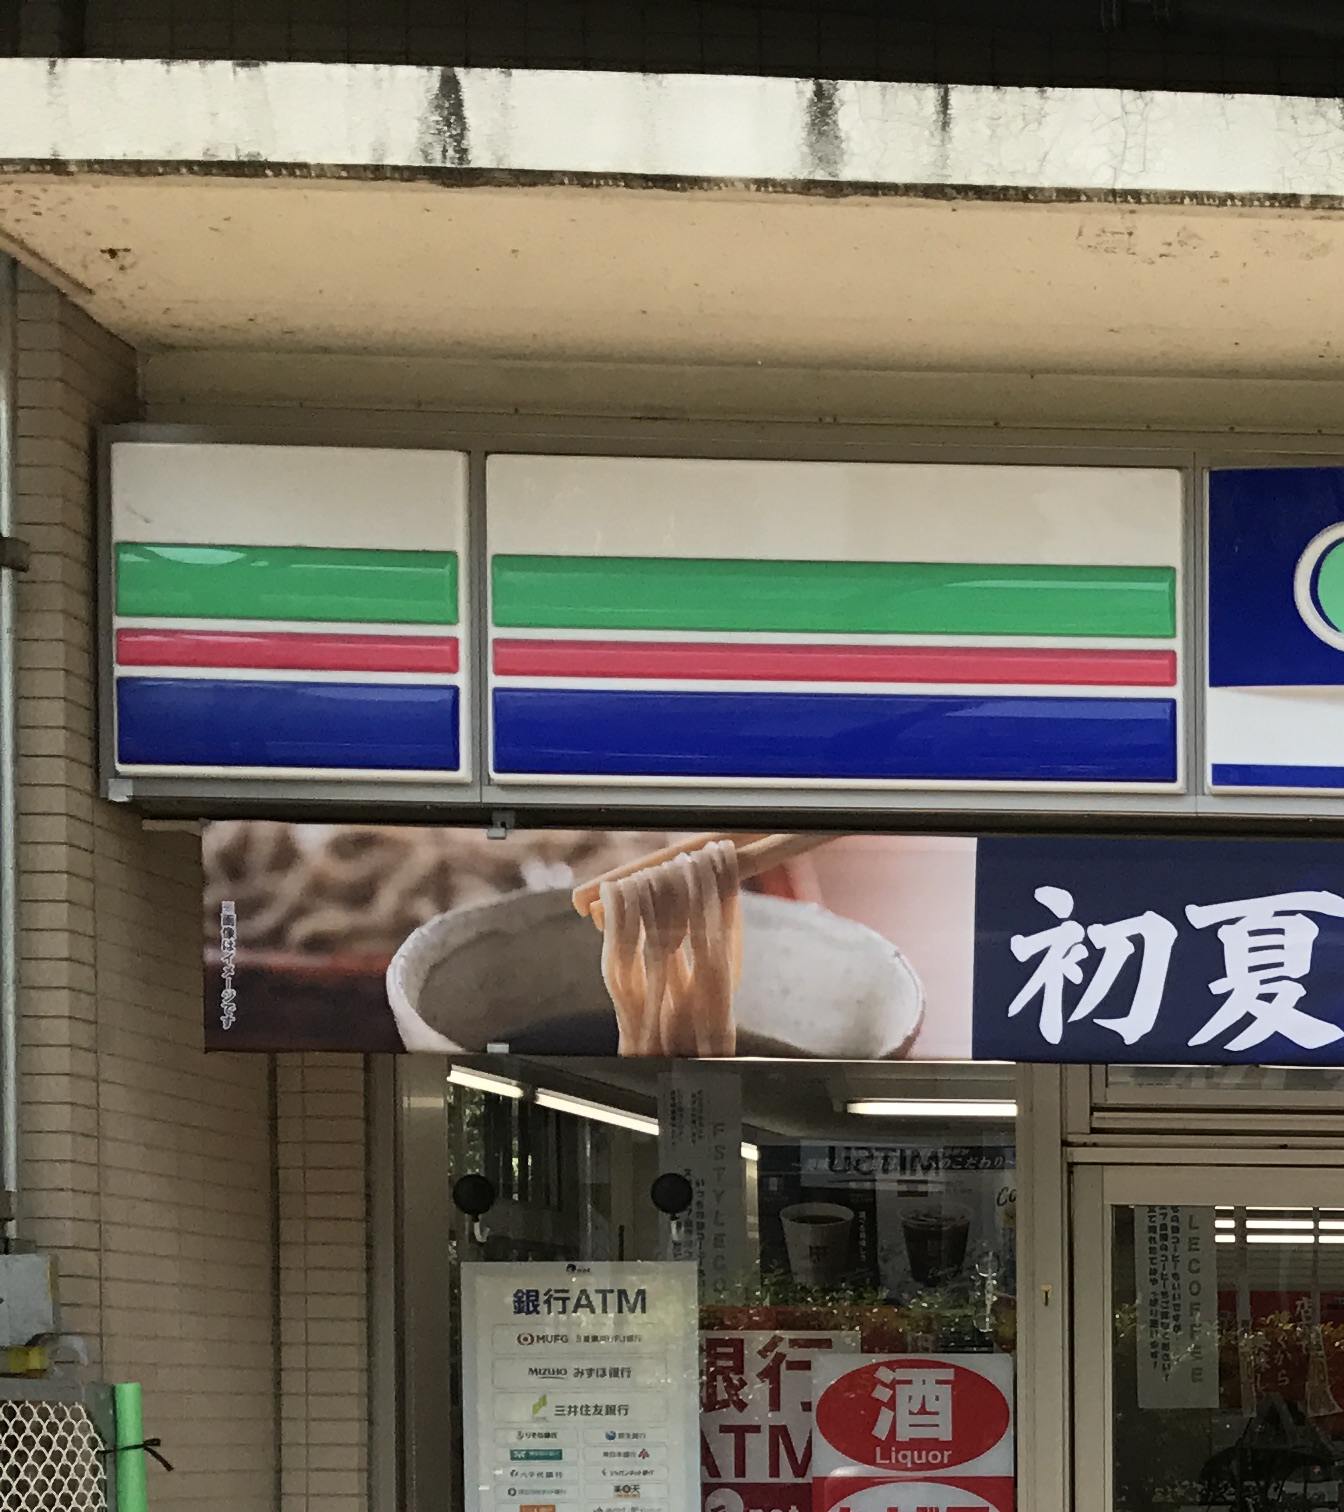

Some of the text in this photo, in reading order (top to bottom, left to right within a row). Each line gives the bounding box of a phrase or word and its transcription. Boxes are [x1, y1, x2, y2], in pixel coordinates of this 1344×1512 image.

[512, 1288, 647, 1315] 銀行ATM
[536, 1334, 569, 1344] MUFG
[528, 1367, 632, 1379] MIZUHO みずほ銀行
[554, 1404, 629, 1417] 三井住友銀行
[871, 1366, 956, 1443] 酒
[874, 1444, 953, 1471] Liquor
